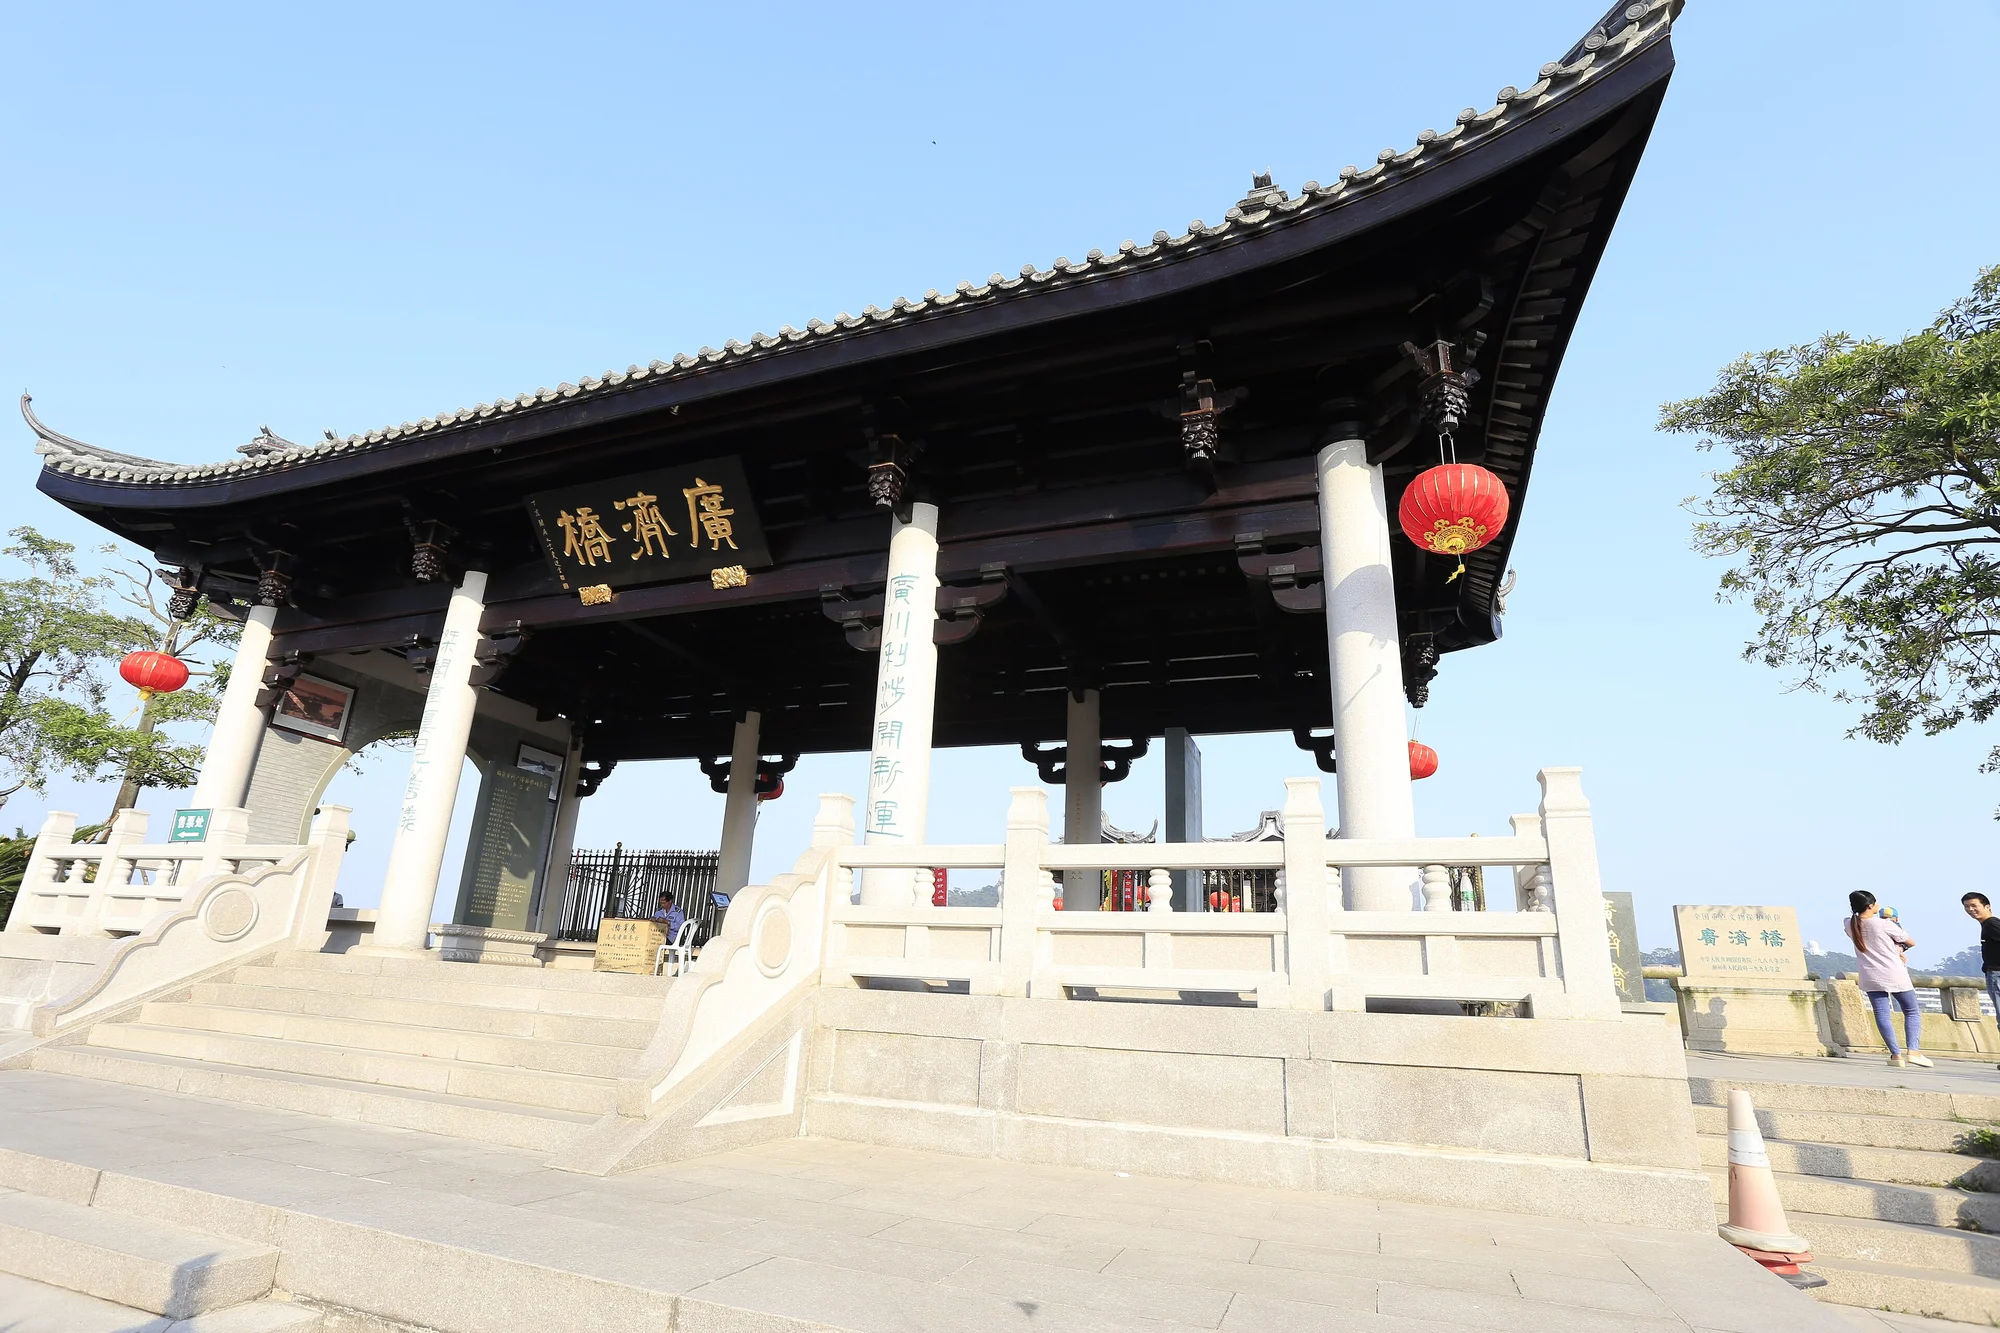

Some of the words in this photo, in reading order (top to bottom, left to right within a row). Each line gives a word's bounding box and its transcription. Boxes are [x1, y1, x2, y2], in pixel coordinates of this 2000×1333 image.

[556, 477, 739, 567] 廣濟橋
[177, 815, 205, 829] 售票处
[1697, 927, 1786, 948] 廣濟橋
